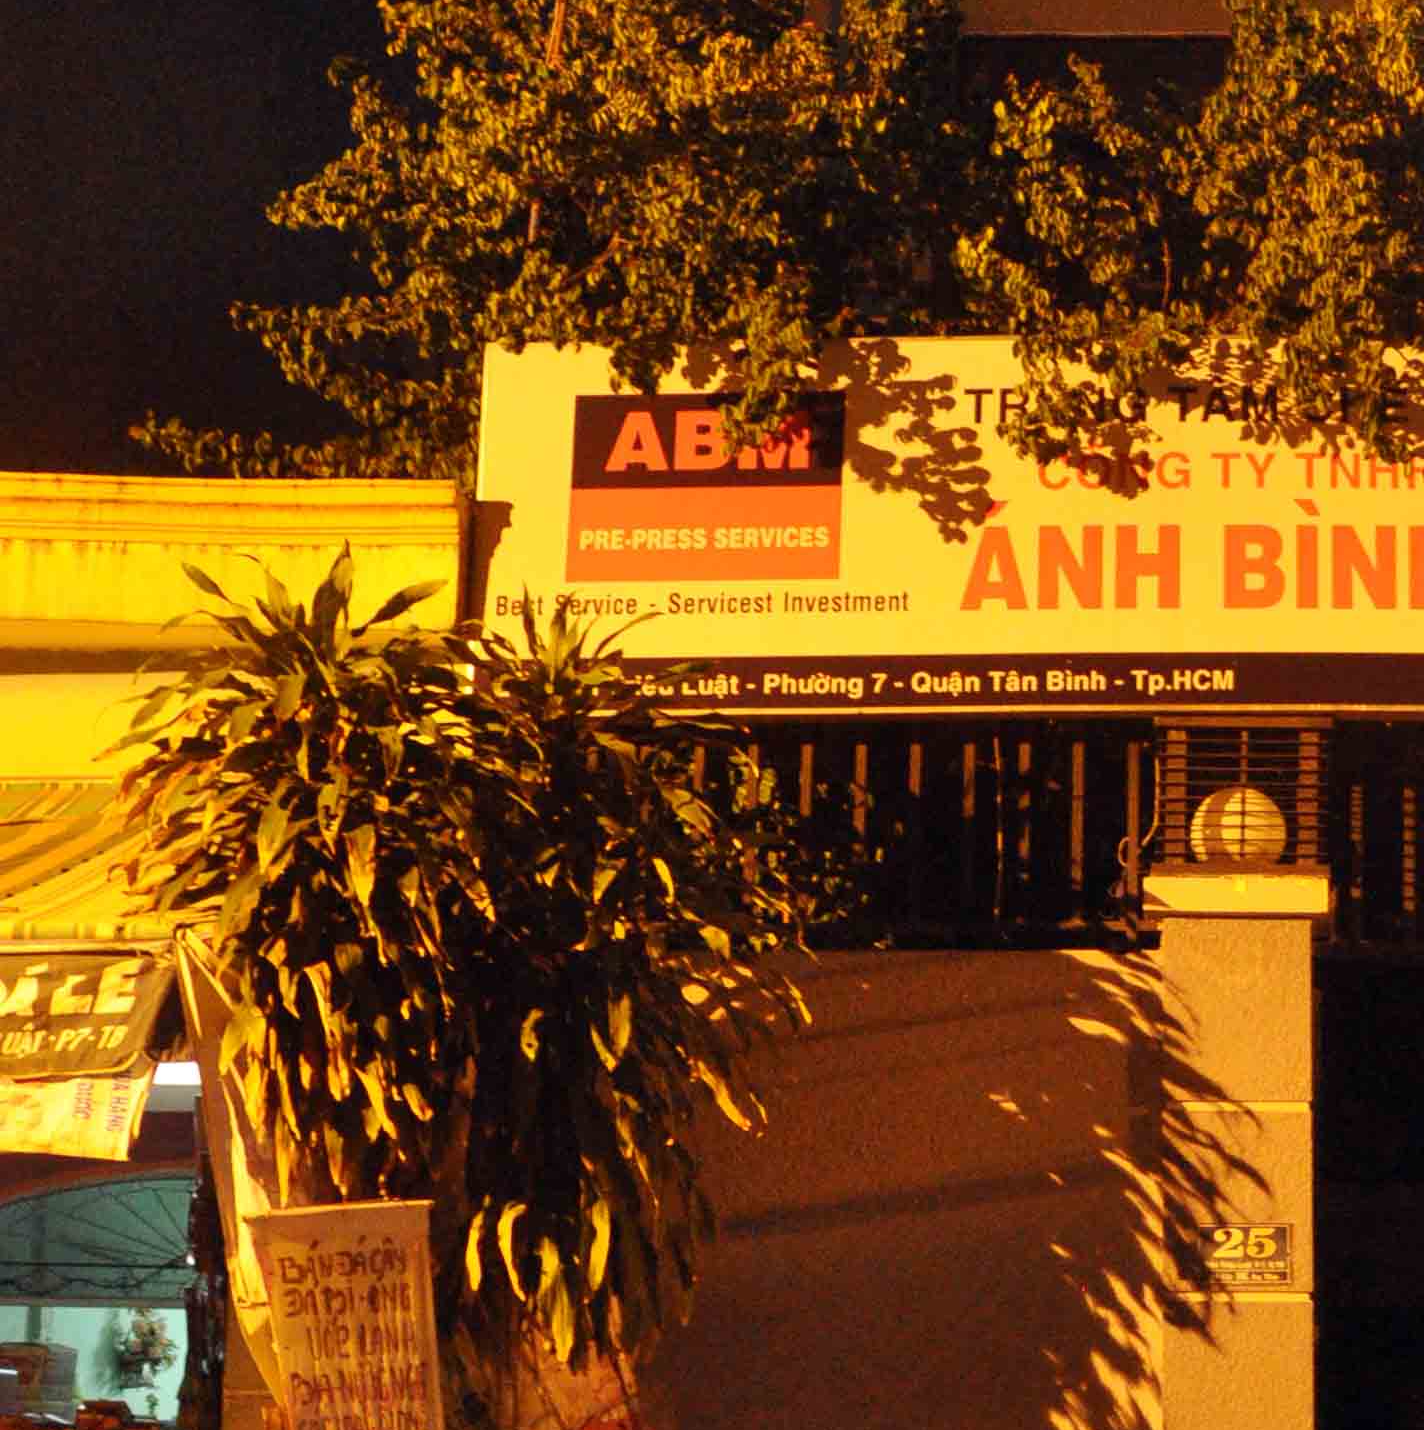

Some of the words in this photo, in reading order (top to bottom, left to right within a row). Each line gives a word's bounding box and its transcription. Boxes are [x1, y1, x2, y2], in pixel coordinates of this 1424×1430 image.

[605, 410, 812, 472] ABM
[1210, 451, 1276, 489] TY
[579, 528, 708, 552] PRE-PRESS
[713, 526, 830, 549] SERVICES
[554, 593, 639, 618] Service
[668, 592, 774, 614] Servicest
[784, 591, 909, 614] Investment
[763, 670, 863, 701] Phường
[871, 675, 885, 696] 7
[911, 670, 980, 697] Quận
[989, 669, 1038, 693] Tân
[1047, 669, 1106, 692] Bình
[1131, 669, 1235, 696] Tp.HCM
[1213, 1227, 1277, 1258] 25
